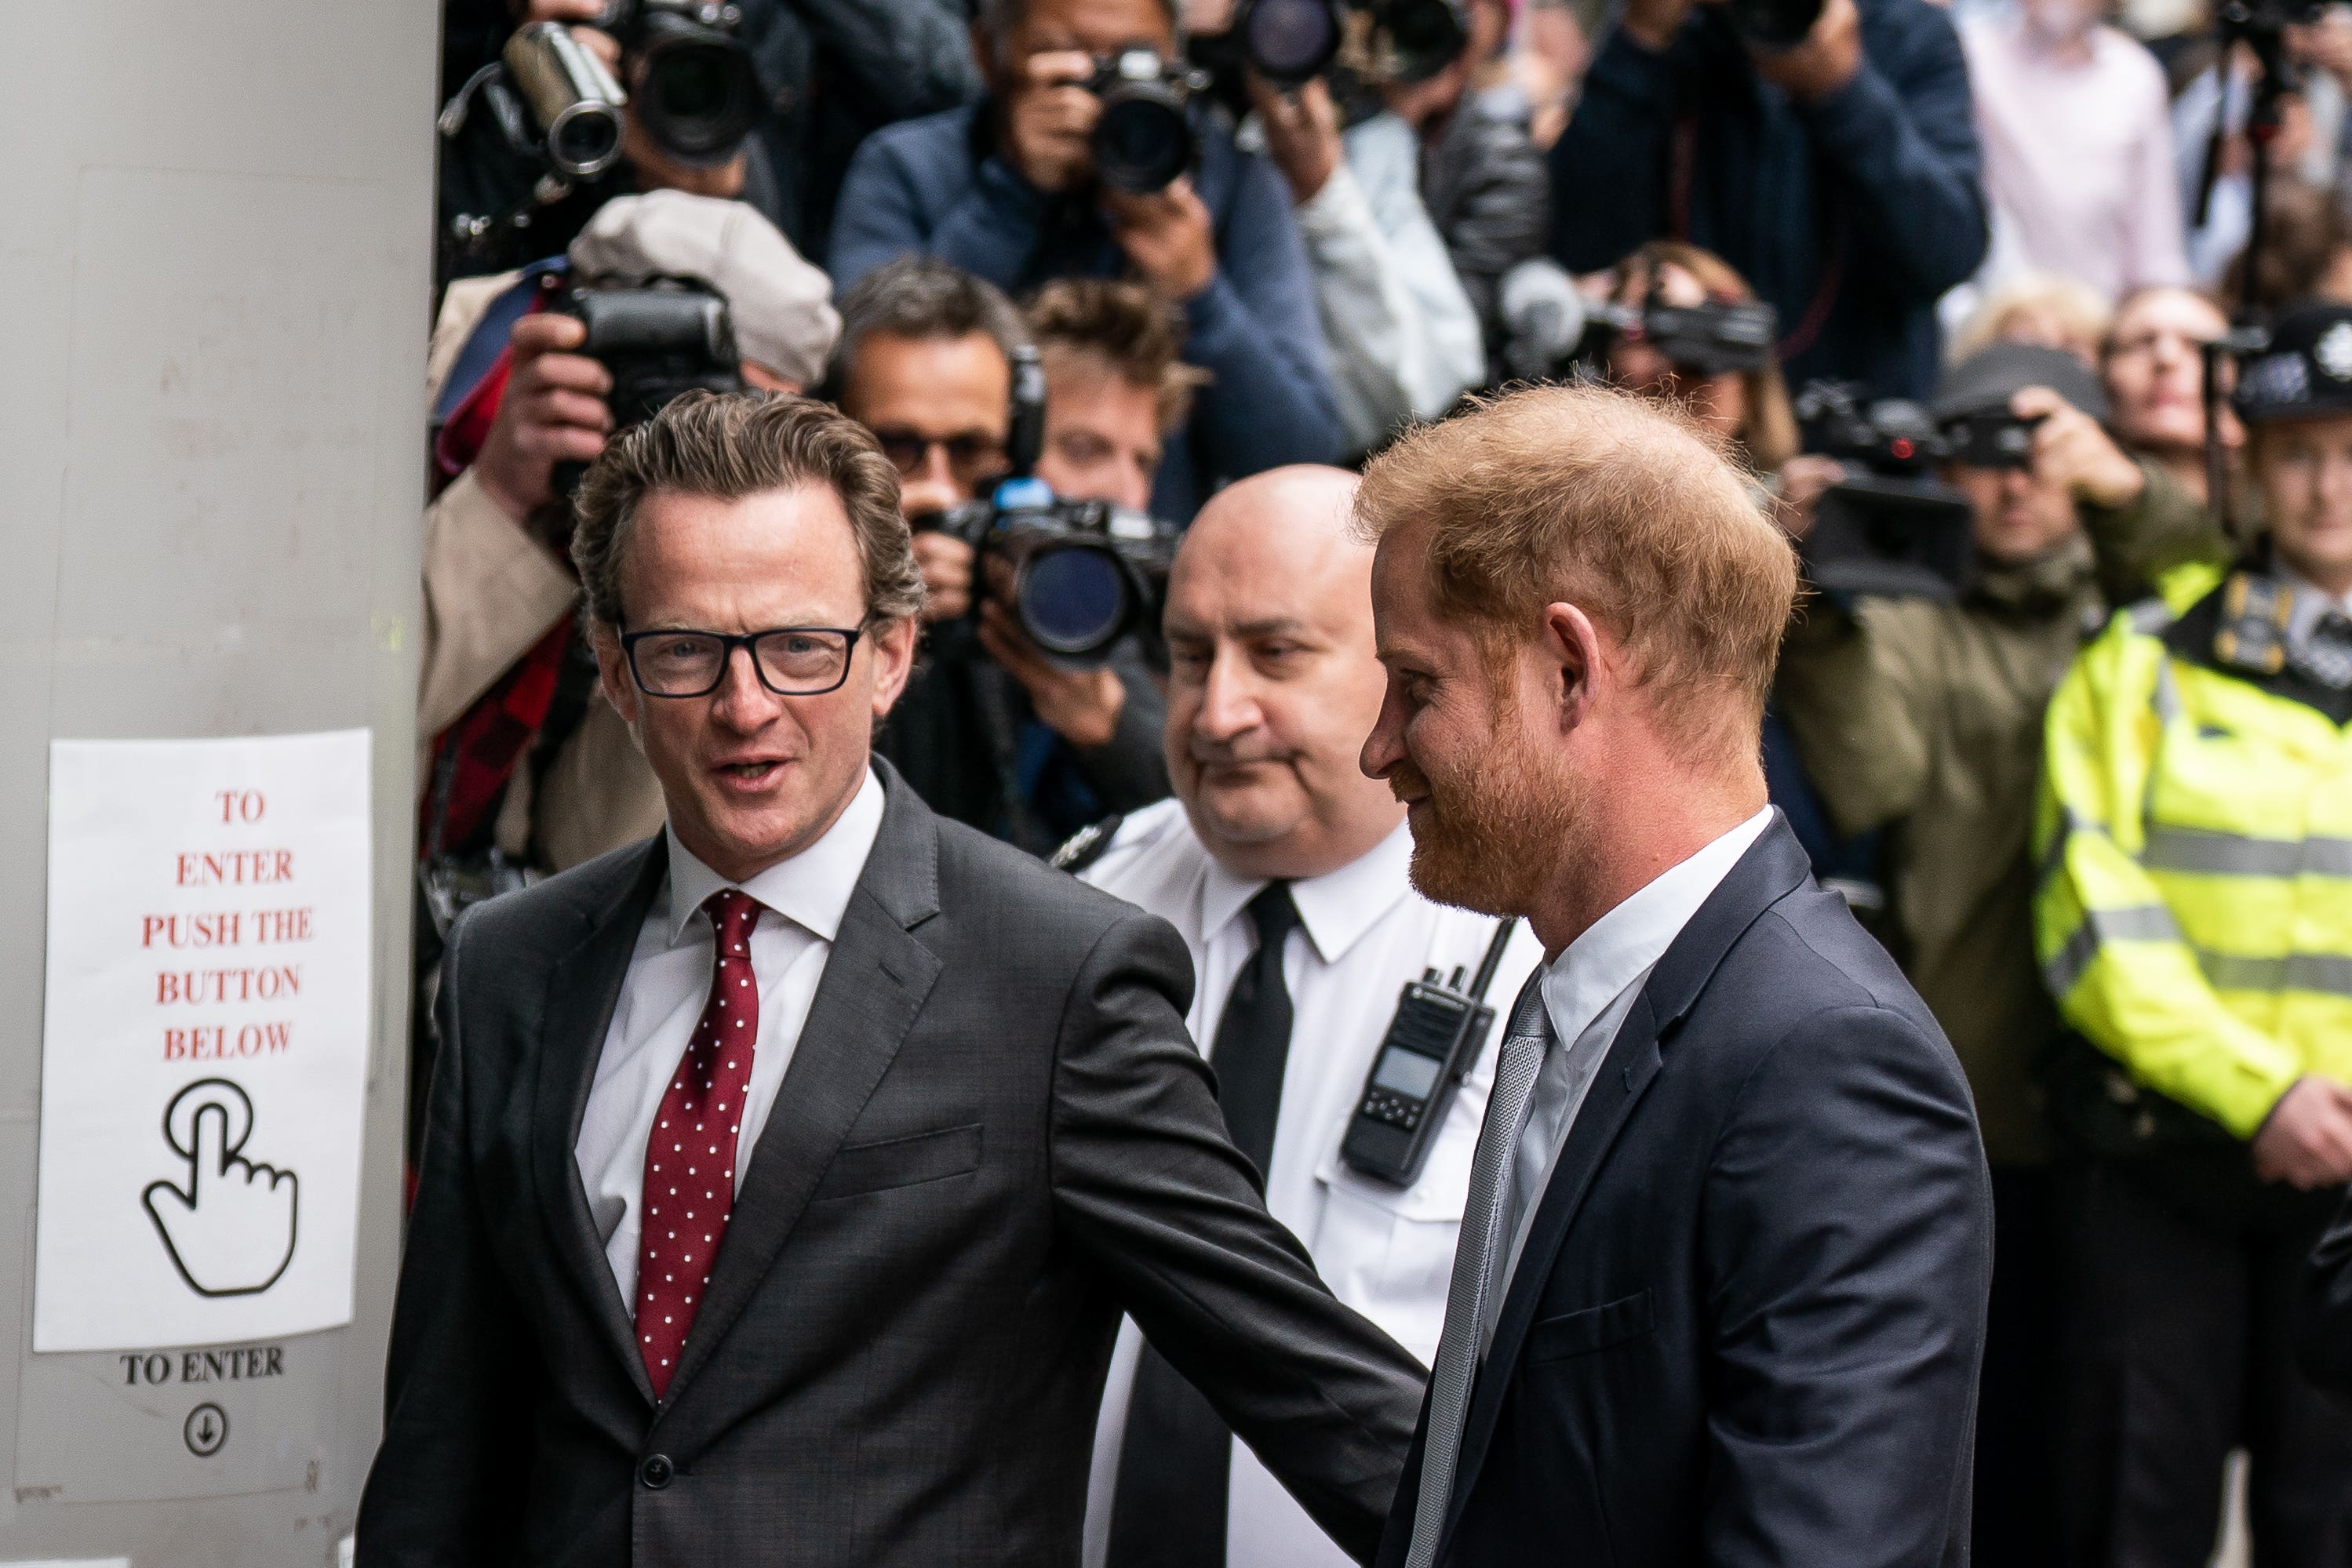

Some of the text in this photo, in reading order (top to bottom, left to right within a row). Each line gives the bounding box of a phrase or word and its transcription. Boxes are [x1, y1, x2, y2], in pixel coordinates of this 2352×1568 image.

[216, 791, 265, 824] TO
[177, 850, 293, 885] ENTER
[143, 908, 314, 948] PUSH THE
[156, 966, 300, 1005] BUTTON
[164, 1022, 292, 1060] BELOW
[120, 1347, 283, 1385] TO ENTER
